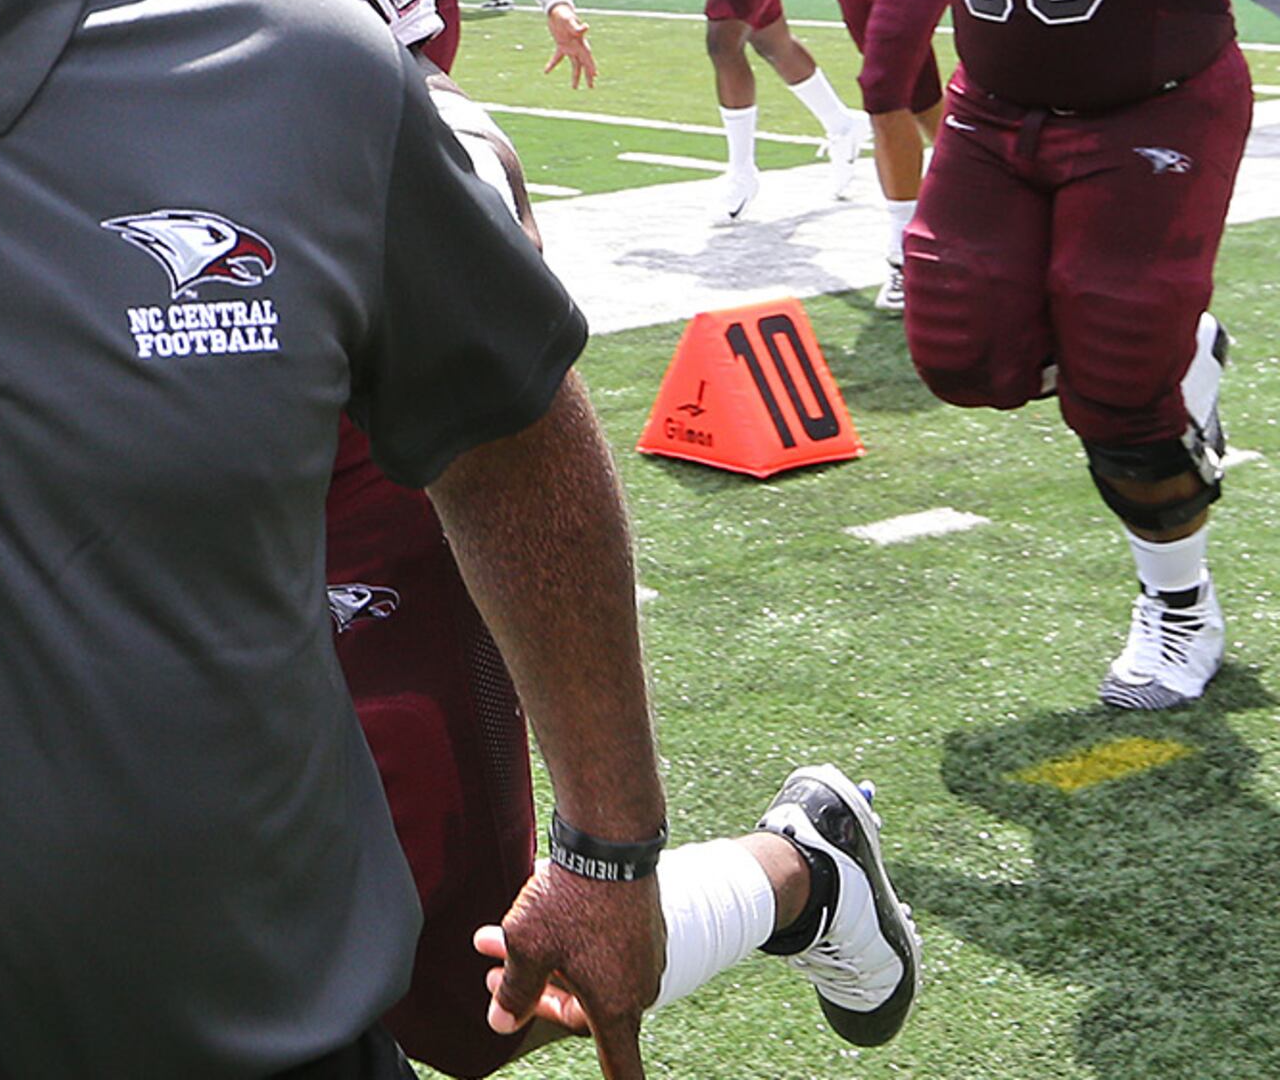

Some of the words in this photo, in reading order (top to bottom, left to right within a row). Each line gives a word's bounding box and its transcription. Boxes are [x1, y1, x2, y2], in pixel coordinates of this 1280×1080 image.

[127, 307, 166, 334] NC
[167, 299, 279, 332] CENTRAL
[134, 325, 280, 358] FOOTBALL
[724, 312, 840, 450] 10
